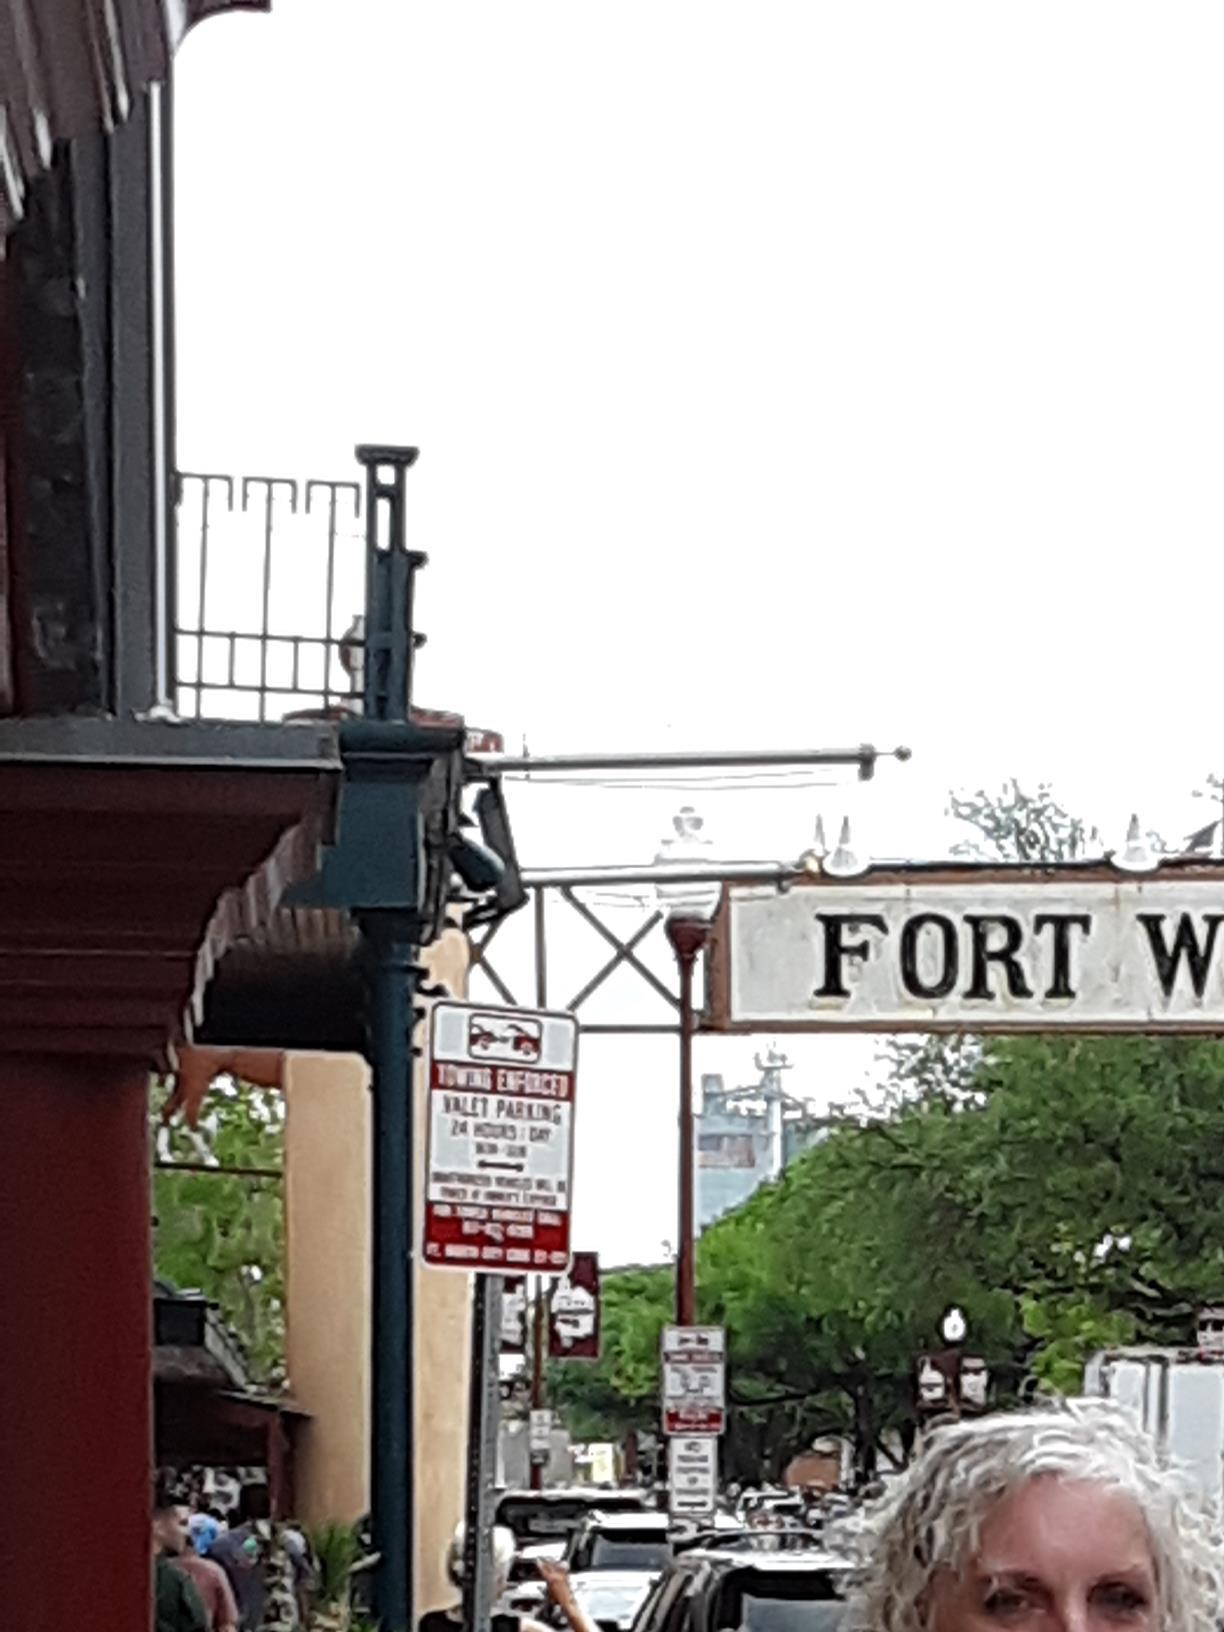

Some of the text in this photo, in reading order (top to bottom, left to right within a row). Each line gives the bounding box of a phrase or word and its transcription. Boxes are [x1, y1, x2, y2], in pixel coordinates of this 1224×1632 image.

[813, 912, 1091, 1000] FORT
[442, 1094, 561, 1125] VALET PARKING
[450, 1119, 468, 1137] 24
[529, 1126, 553, 1142] DAY
